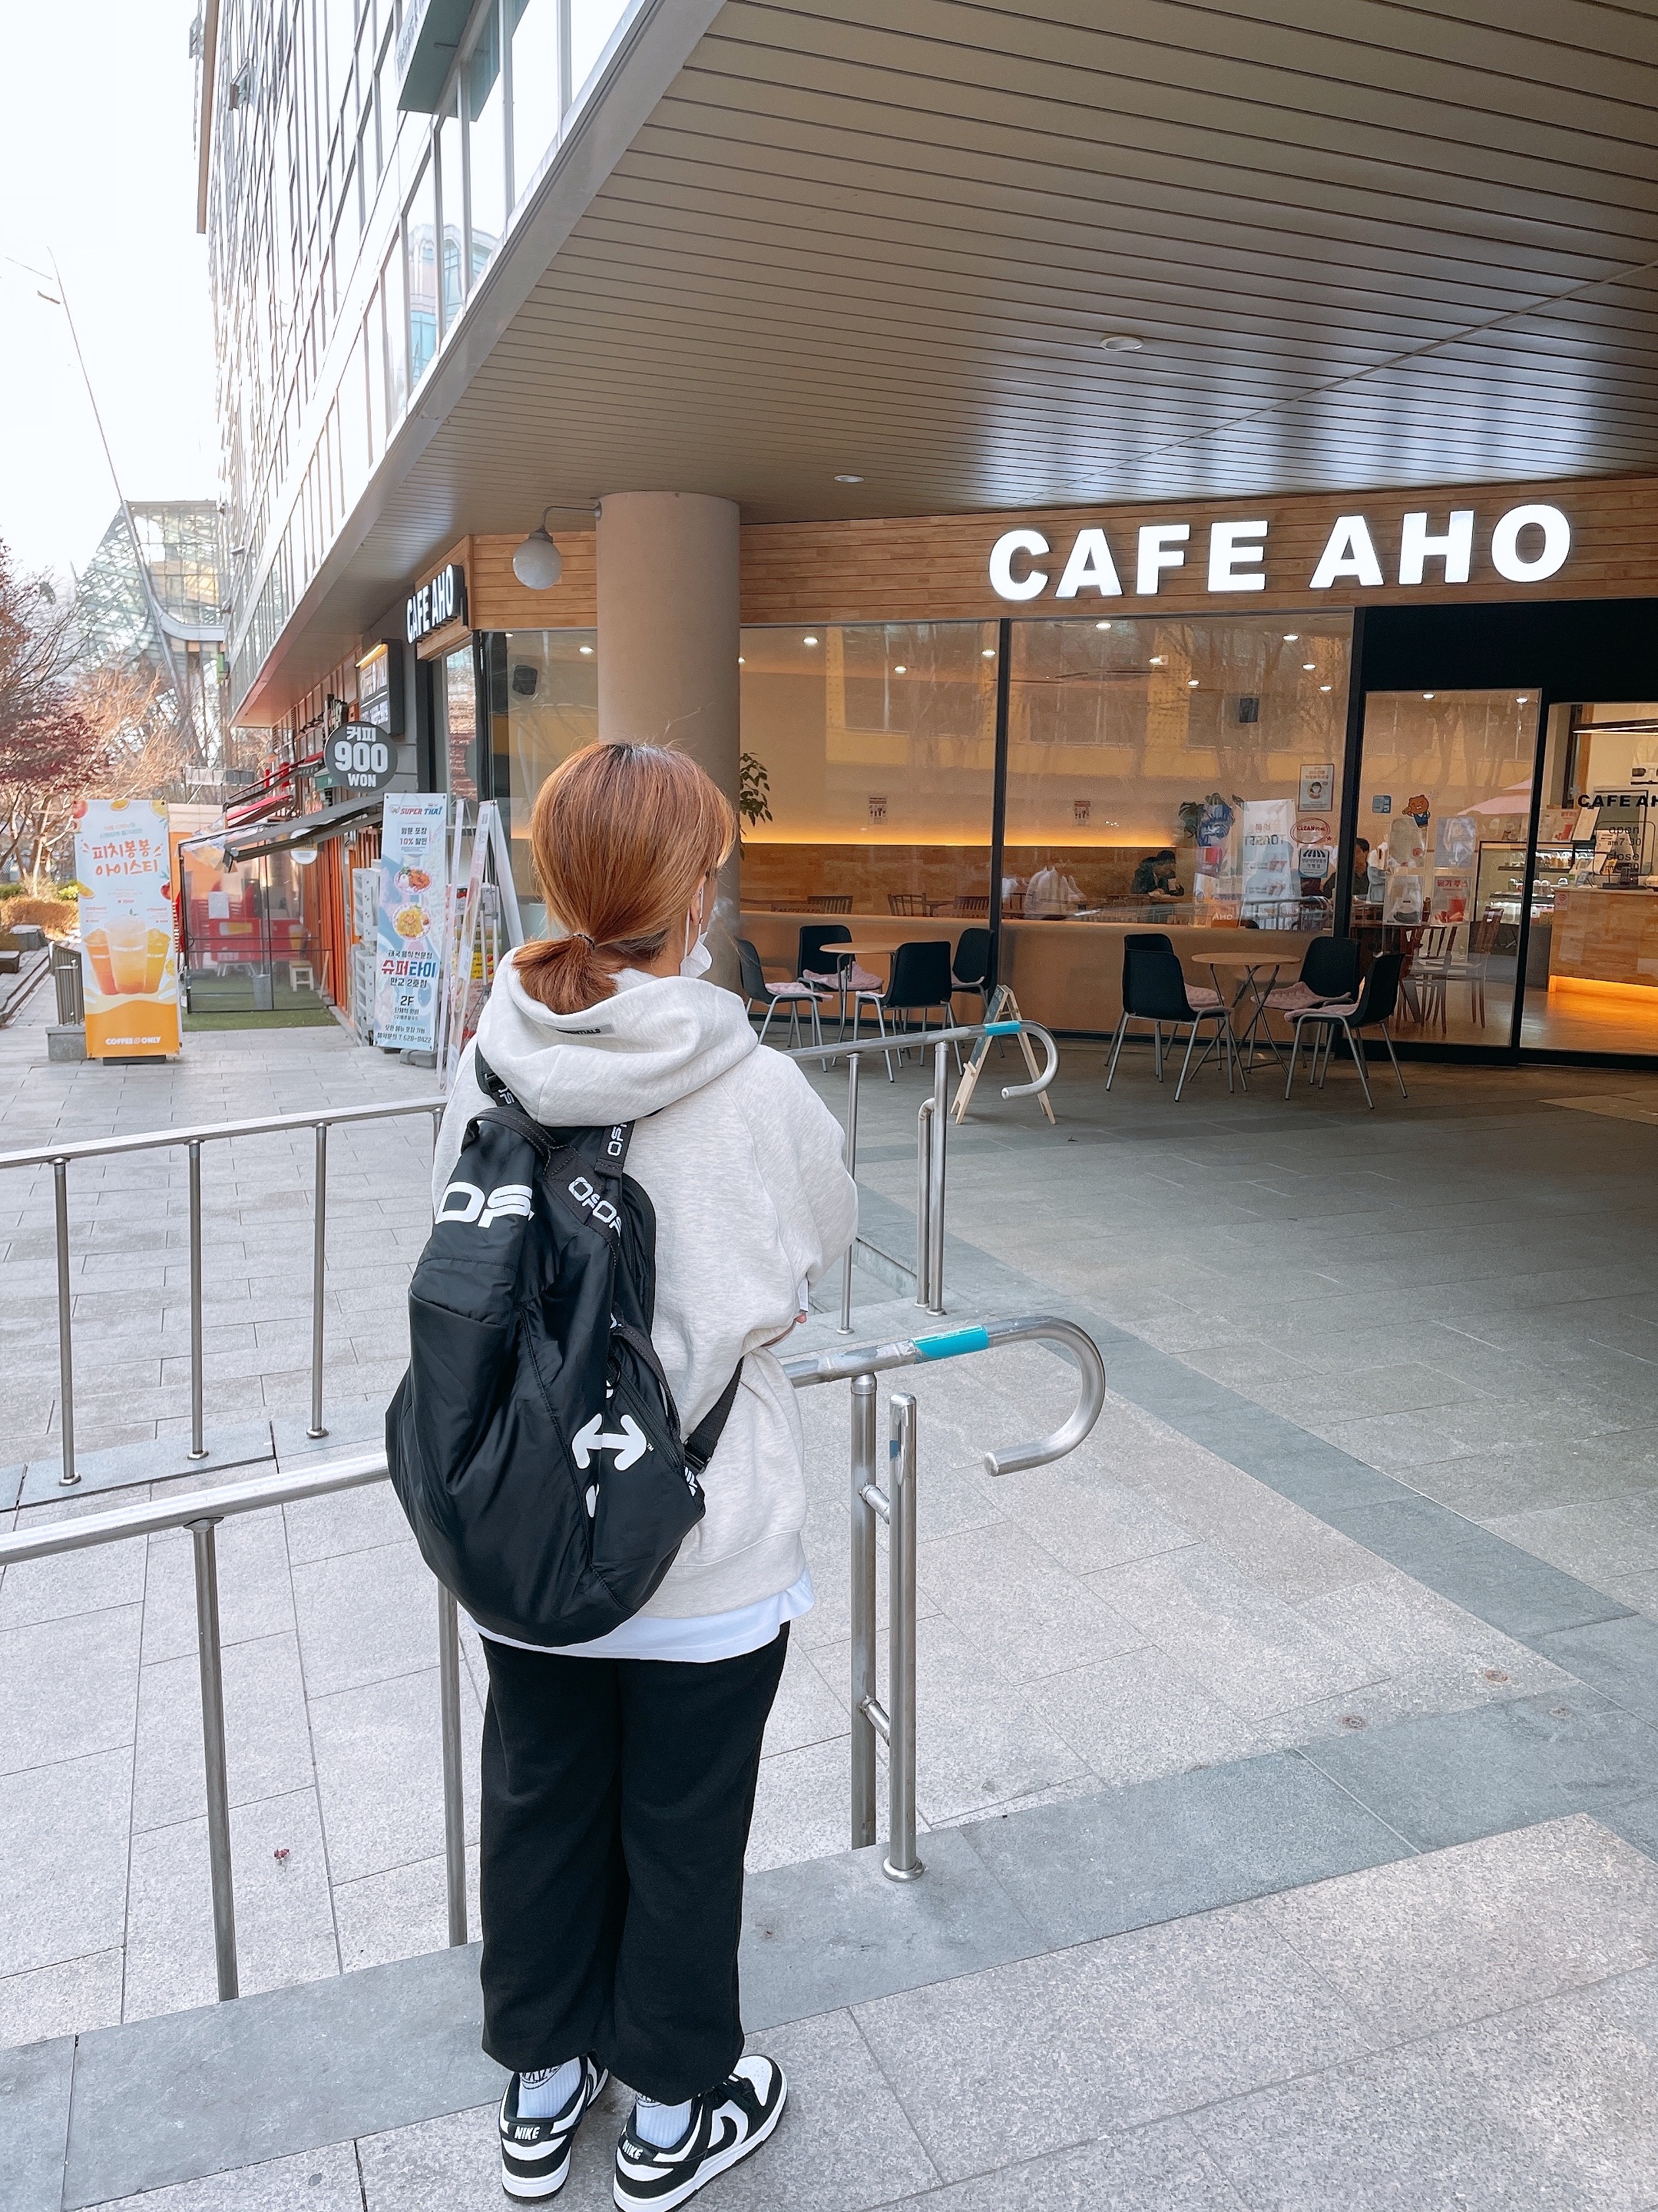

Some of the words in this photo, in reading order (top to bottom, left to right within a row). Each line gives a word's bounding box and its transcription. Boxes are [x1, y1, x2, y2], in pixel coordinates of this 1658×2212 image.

[988, 520, 1269, 601] CAFE
[1309, 504, 1571, 589] AHO
[407, 585, 430, 644] CAFE
[432, 564, 454, 627] AHO
[346, 726, 376, 742] 커피
[334, 740, 388, 773] 900
[347, 773, 376, 787] WON
[1578, 794, 1631, 807] CAFE
[1608, 826, 1640, 836] open
[92, 839, 151, 859] 피치봉봉
[1607, 851, 1640, 861] close
[95, 859, 158, 876] 아이스티
[381, 959, 437, 978] 슈퍼타이
[400, 995, 415, 1006] 2F
[514, 2126, 540, 2141] NIKE
[622, 2139, 643, 2161] NIKE
